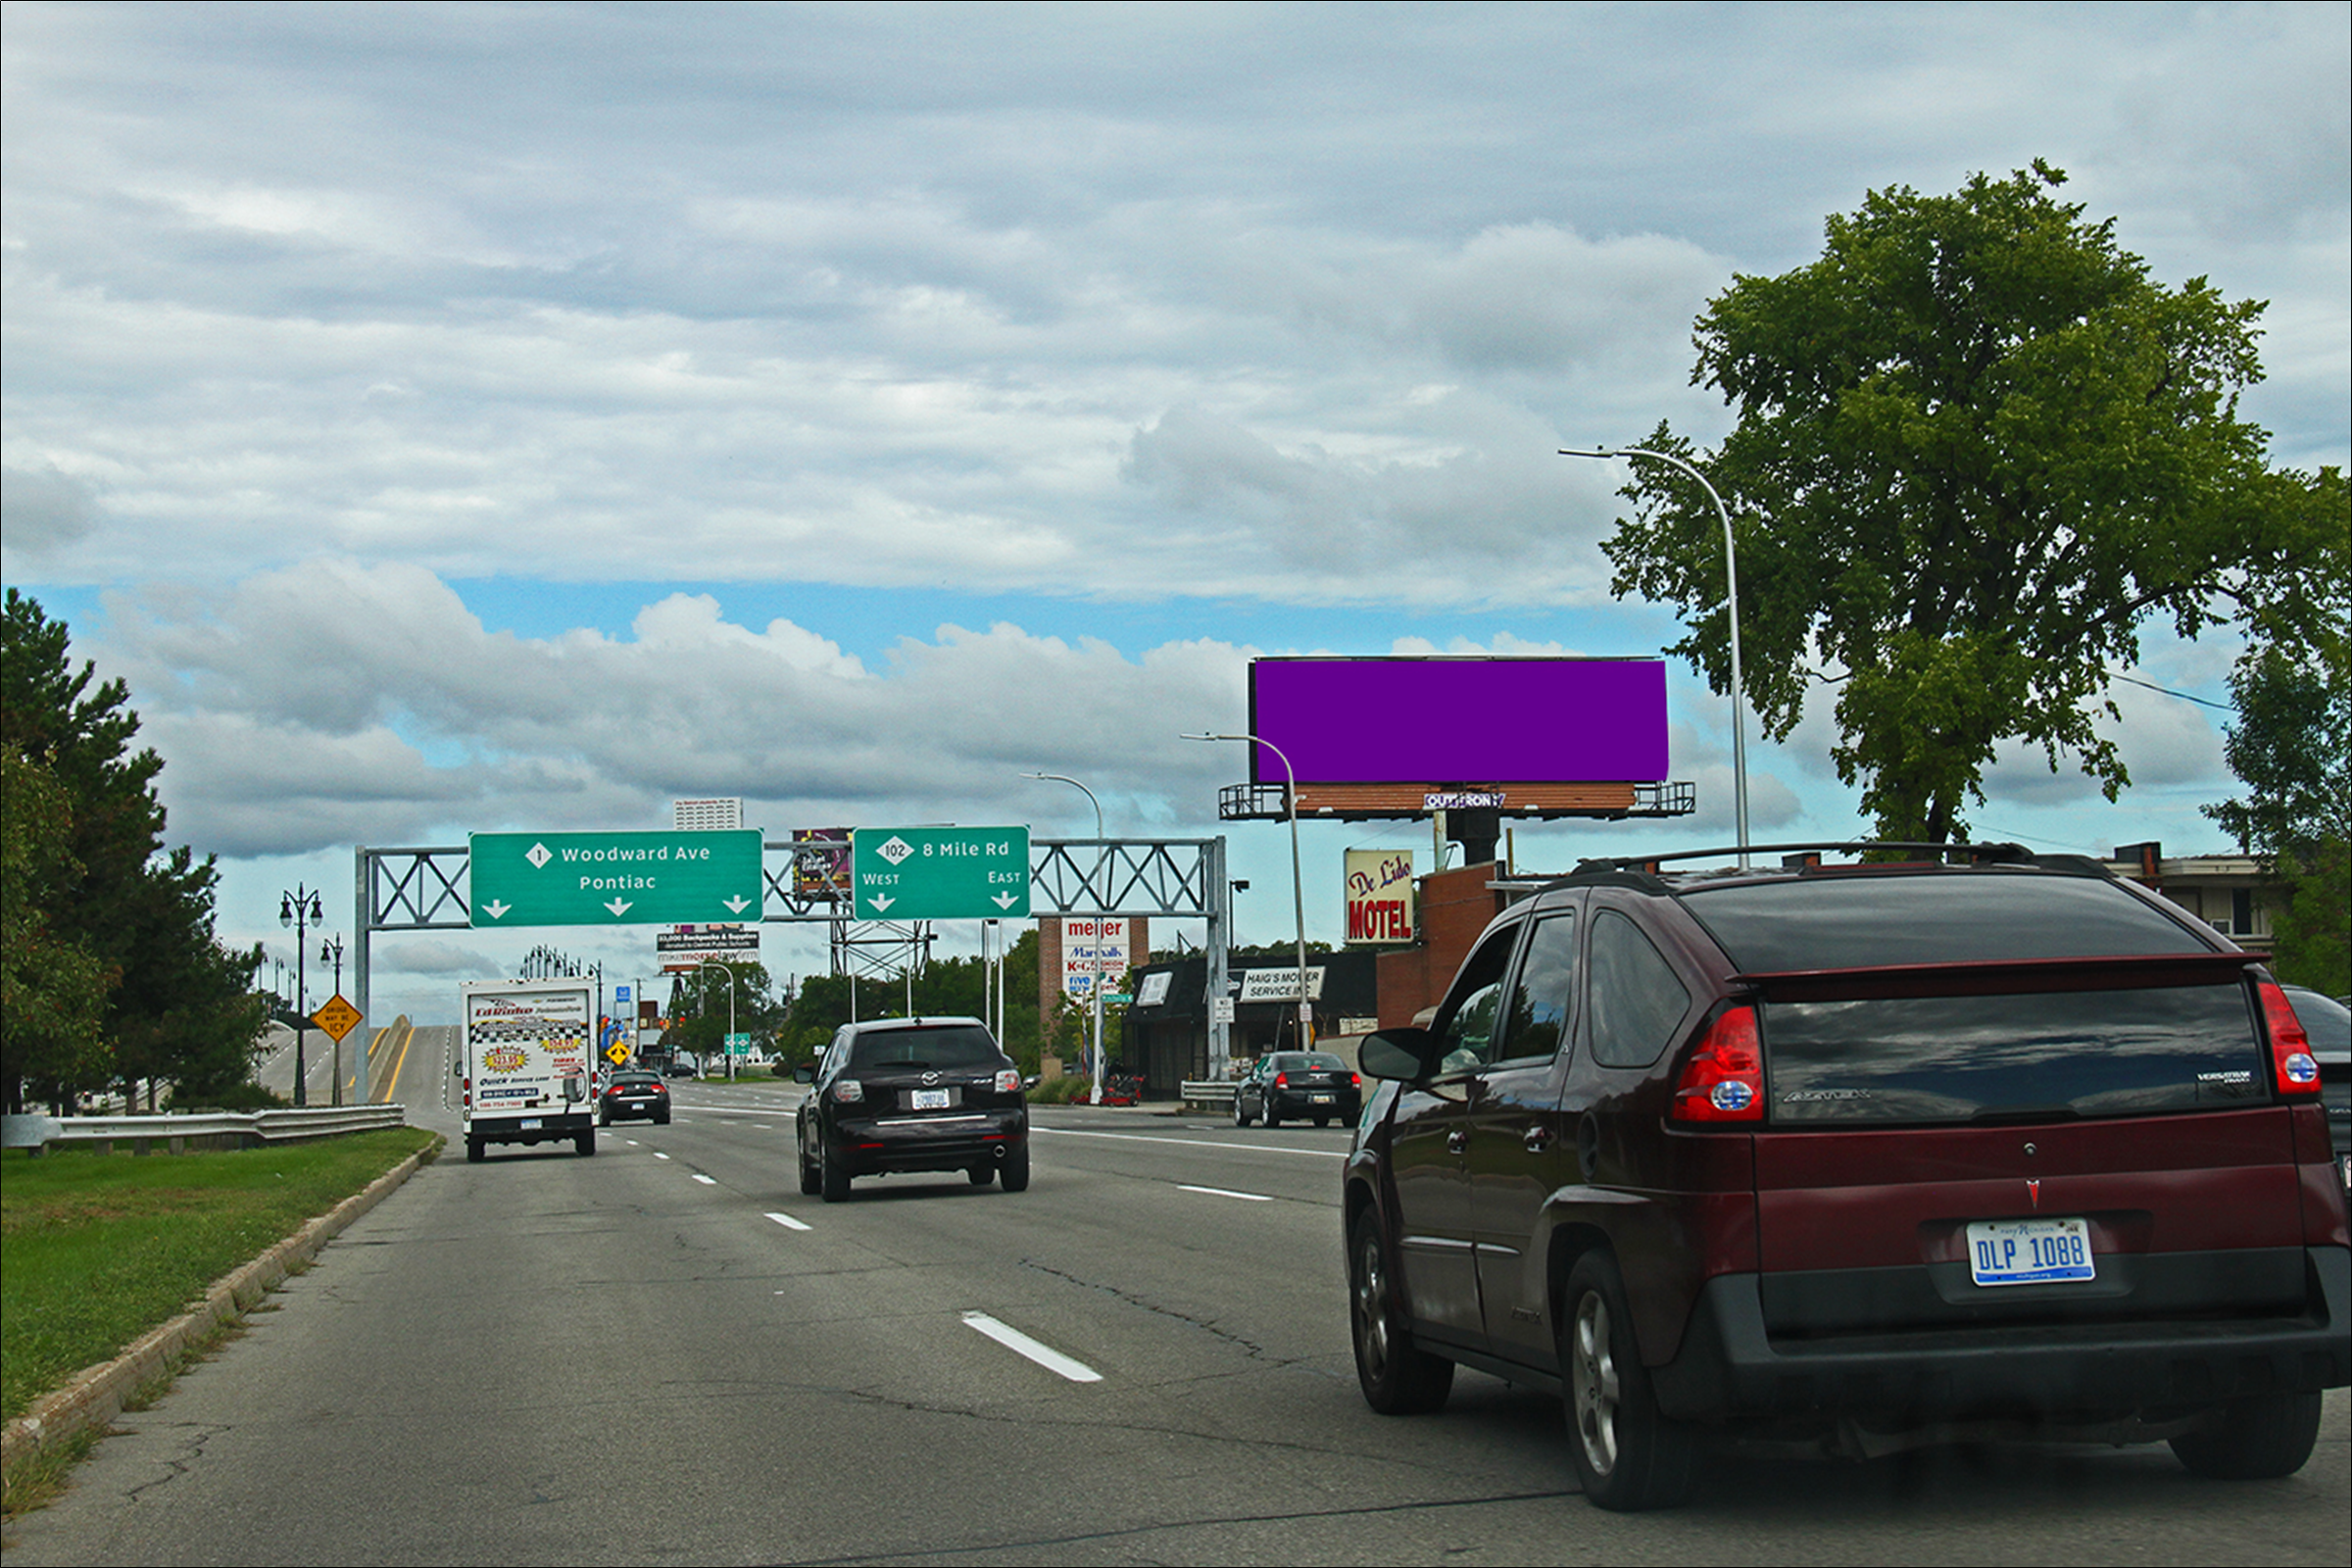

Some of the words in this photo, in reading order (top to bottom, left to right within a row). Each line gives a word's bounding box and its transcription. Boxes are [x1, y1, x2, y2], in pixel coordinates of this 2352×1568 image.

[536, 849, 542, 860] 1
[562, 847, 667, 861] Woodward
[675, 847, 710, 860] Ave
[885, 844, 906, 857] 102
[922, 844, 933, 857] 8
[940, 843, 979, 857] Mile
[986, 842, 1008, 856] Rd
[580, 876, 656, 890] Pontiac
[862, 873, 900, 885] WEST
[988, 871, 1021, 884] EAST
[1348, 871, 1376, 897] De
[1380, 855, 1411, 889] Lido
[1348, 900, 1411, 940] MOTEL
[1068, 917, 1122, 939] meijer
[1069, 947, 1122, 958] Maralls
[1247, 973, 1280, 984] HAIG'S
[1250, 986, 1292, 997] SERVICE
[329, 1022, 346, 1032] ICY
[1977, 1239, 2016, 1270] DLP
[2030, 1236, 2084, 1267] 1088
